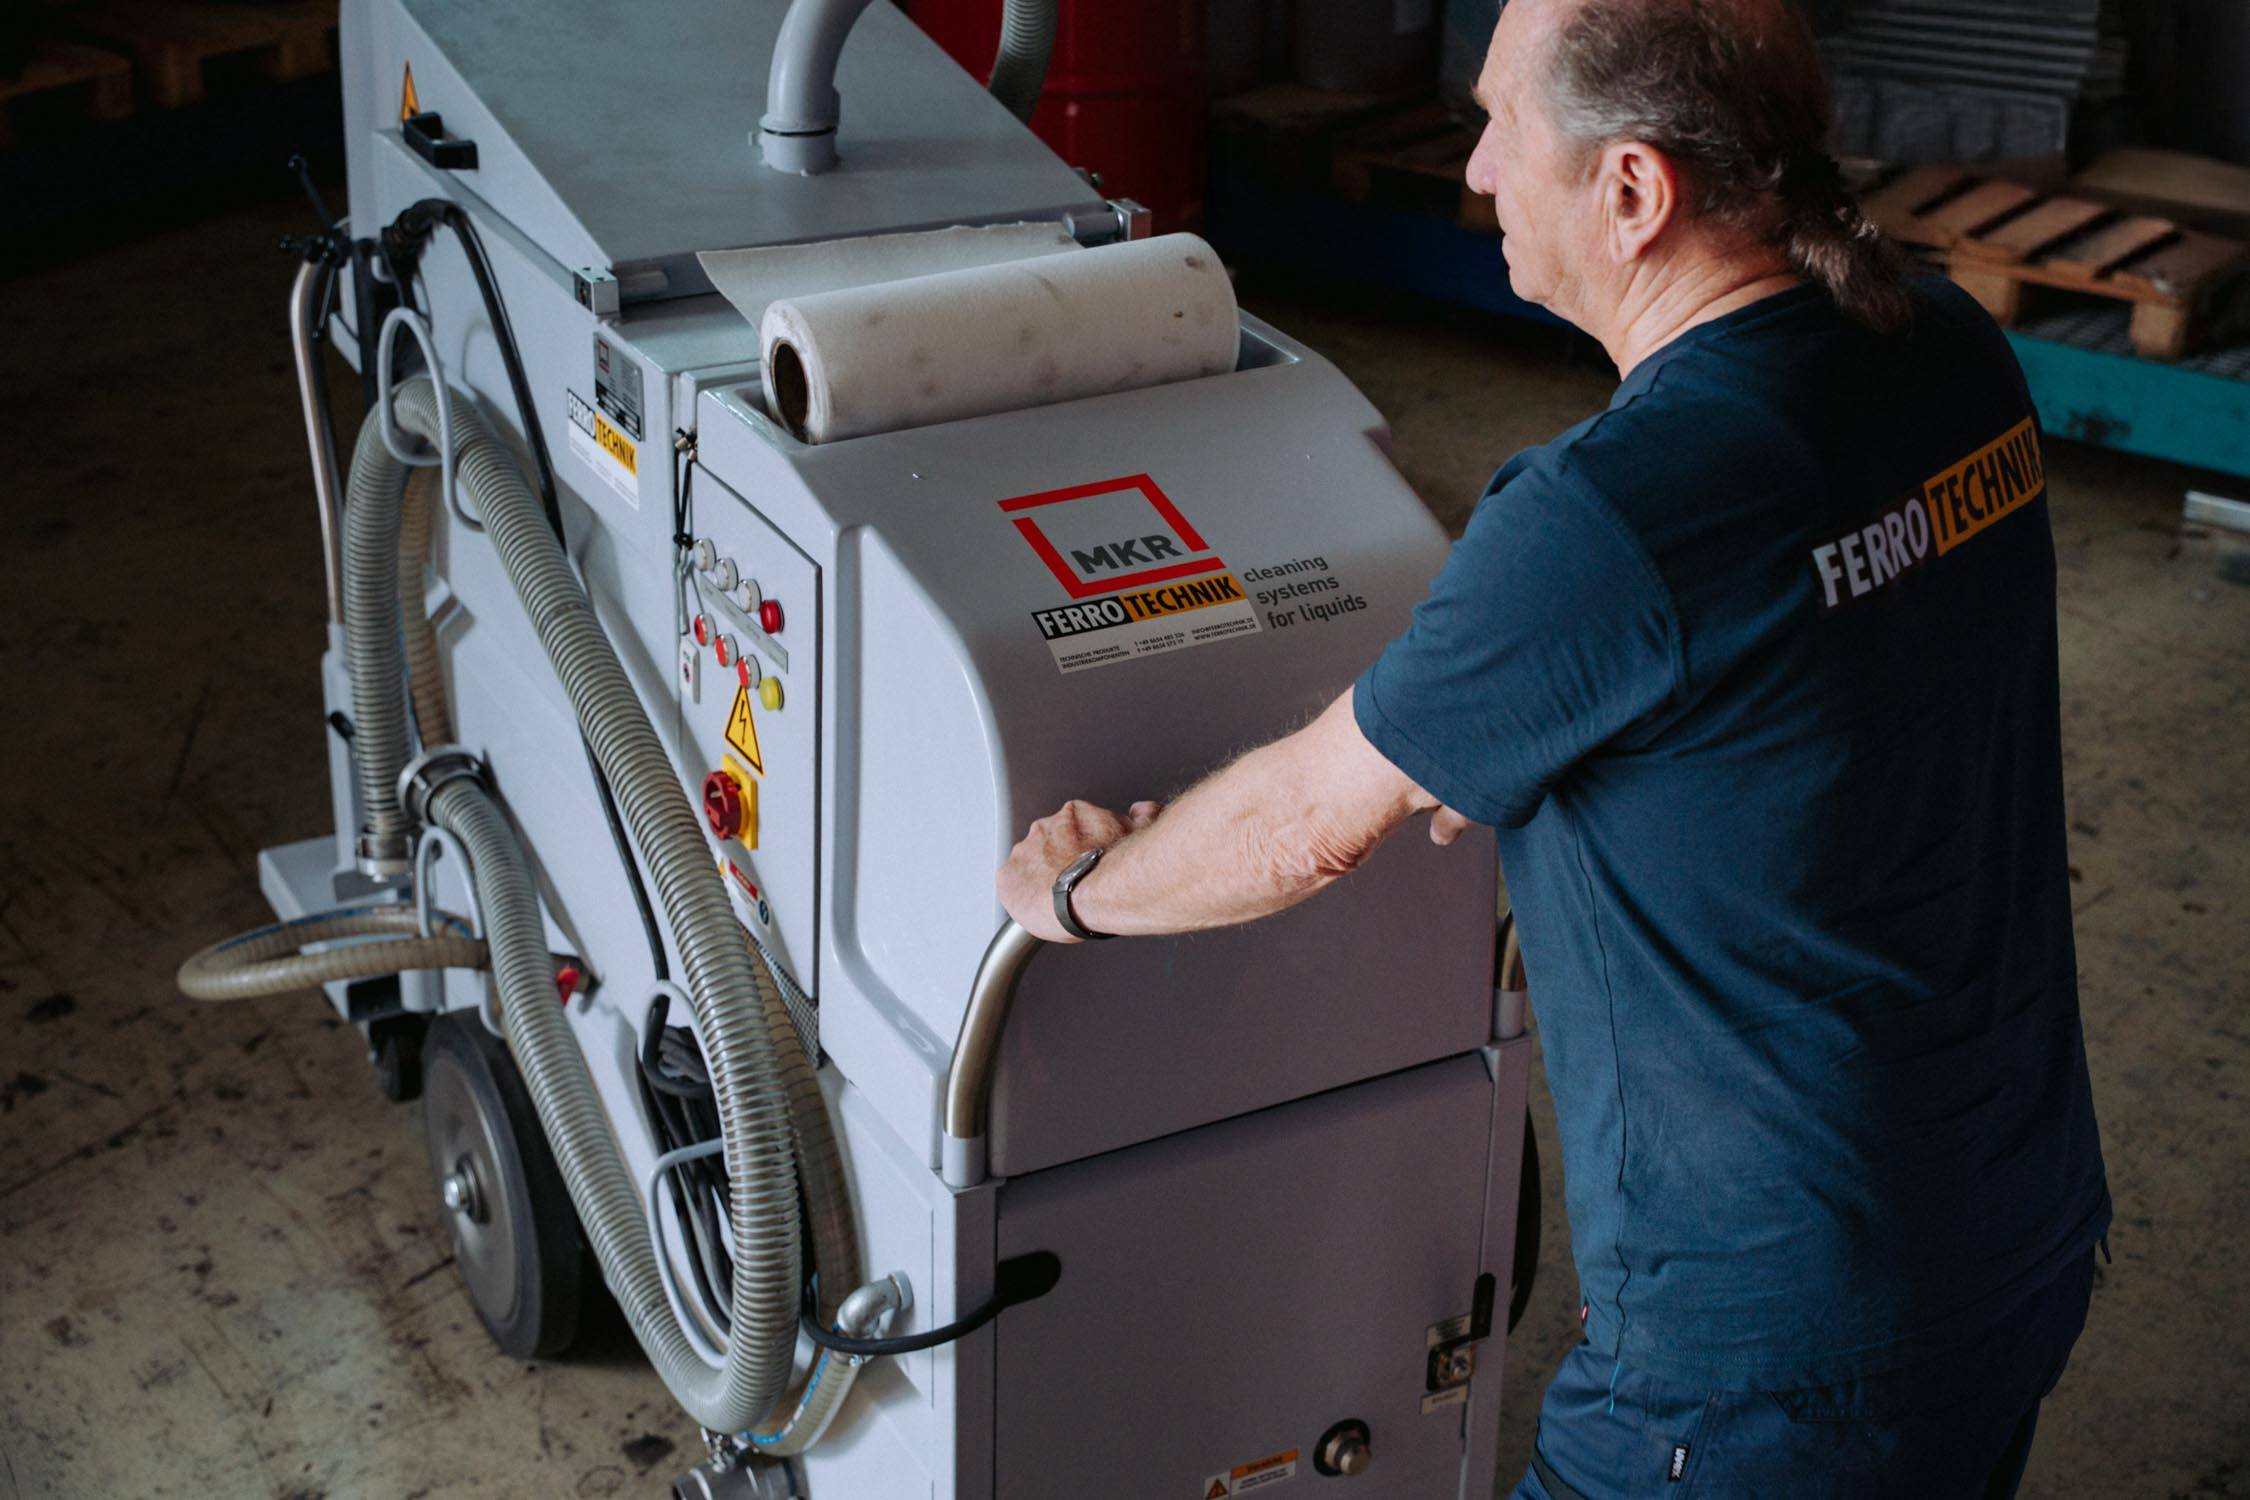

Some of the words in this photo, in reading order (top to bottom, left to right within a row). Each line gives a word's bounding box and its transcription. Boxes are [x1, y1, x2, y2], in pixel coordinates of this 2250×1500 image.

[1070, 534, 1183, 574] MKR
[1244, 554, 1329, 583] cleaning
[1256, 574, 1340, 606] systems
[1267, 609, 1297, 630] for
[1300, 593, 1368, 623] liquids
